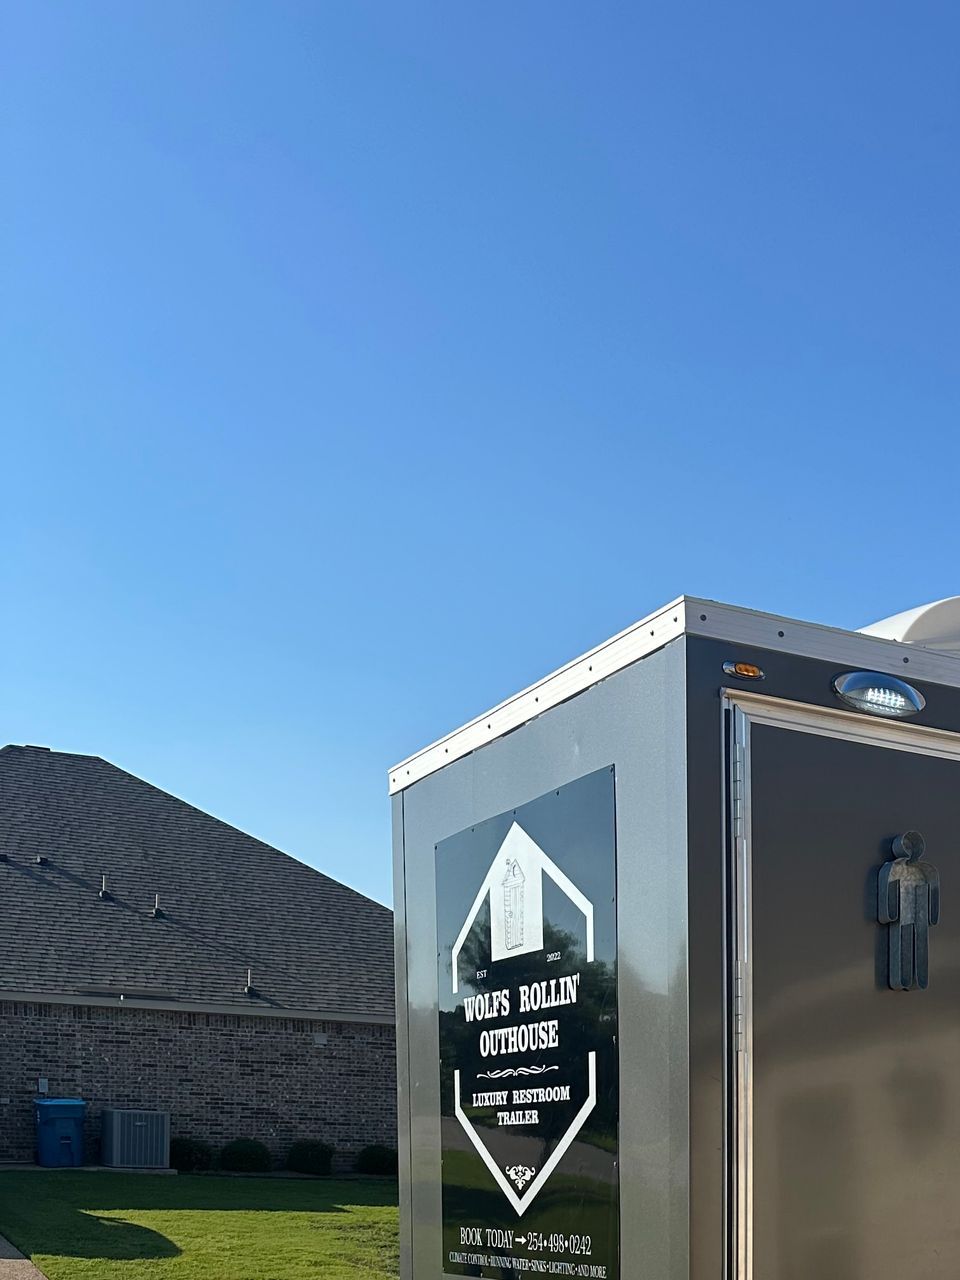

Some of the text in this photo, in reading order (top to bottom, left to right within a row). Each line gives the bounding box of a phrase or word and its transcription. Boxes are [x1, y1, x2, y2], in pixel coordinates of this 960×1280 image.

[476, 969, 487, 979] EST
[463, 972, 580, 1023] WOLFS ROLLIN'
[479, 1019, 559, 1057] OUTHOUSE
[472, 1085, 571, 1107] LUXURY RESTROOM
[497, 1109, 539, 1126] TRAILER
[460, 1227, 483, 1246] BOOK
[485, 1228, 514, 1249] TODAY
[467, 1253, 489, 1266] CONTROL
[511, 1257, 530, 1271] WATER
[530, 1259, 547, 1272] SINKS
[548, 1261, 575, 1275] LIGHTING
[577, 1264, 590, 1277] AND
[589, 1265, 607, 1279] MORE
